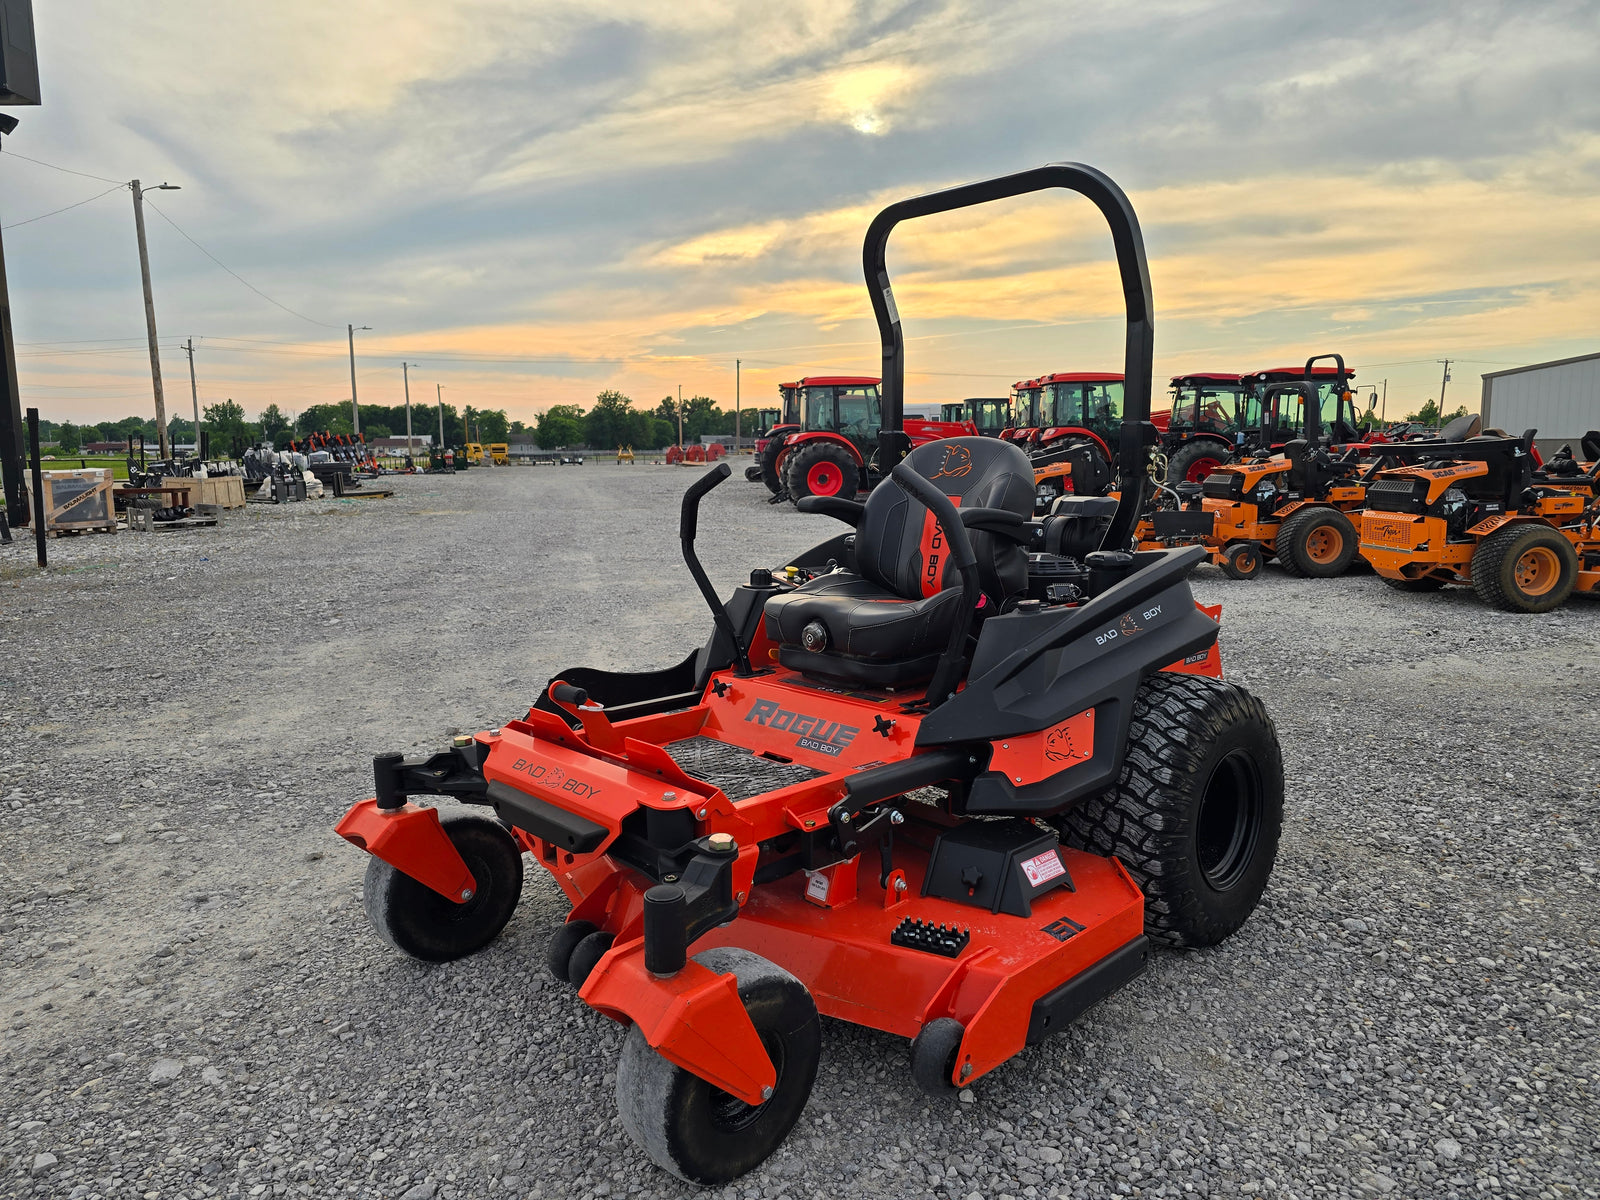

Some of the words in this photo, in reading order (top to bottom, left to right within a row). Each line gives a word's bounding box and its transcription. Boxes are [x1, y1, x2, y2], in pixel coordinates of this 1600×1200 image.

[1432, 469, 1455, 478] SCAG
[932, 518, 943, 549] AD
[927, 555, 939, 589] BOY
[1095, 629, 1118, 646] BAD
[1143, 605, 1162, 620] BOY
[1186, 655, 1196, 664] BAD
[1197, 652, 1208, 661] BOY
[744, 698, 861, 747] ROGUE
[801, 738, 819, 750] BAD
[820, 741, 839, 755] BOY
[512, 758, 546, 778] BAD
[562, 778, 602, 799] BOY
